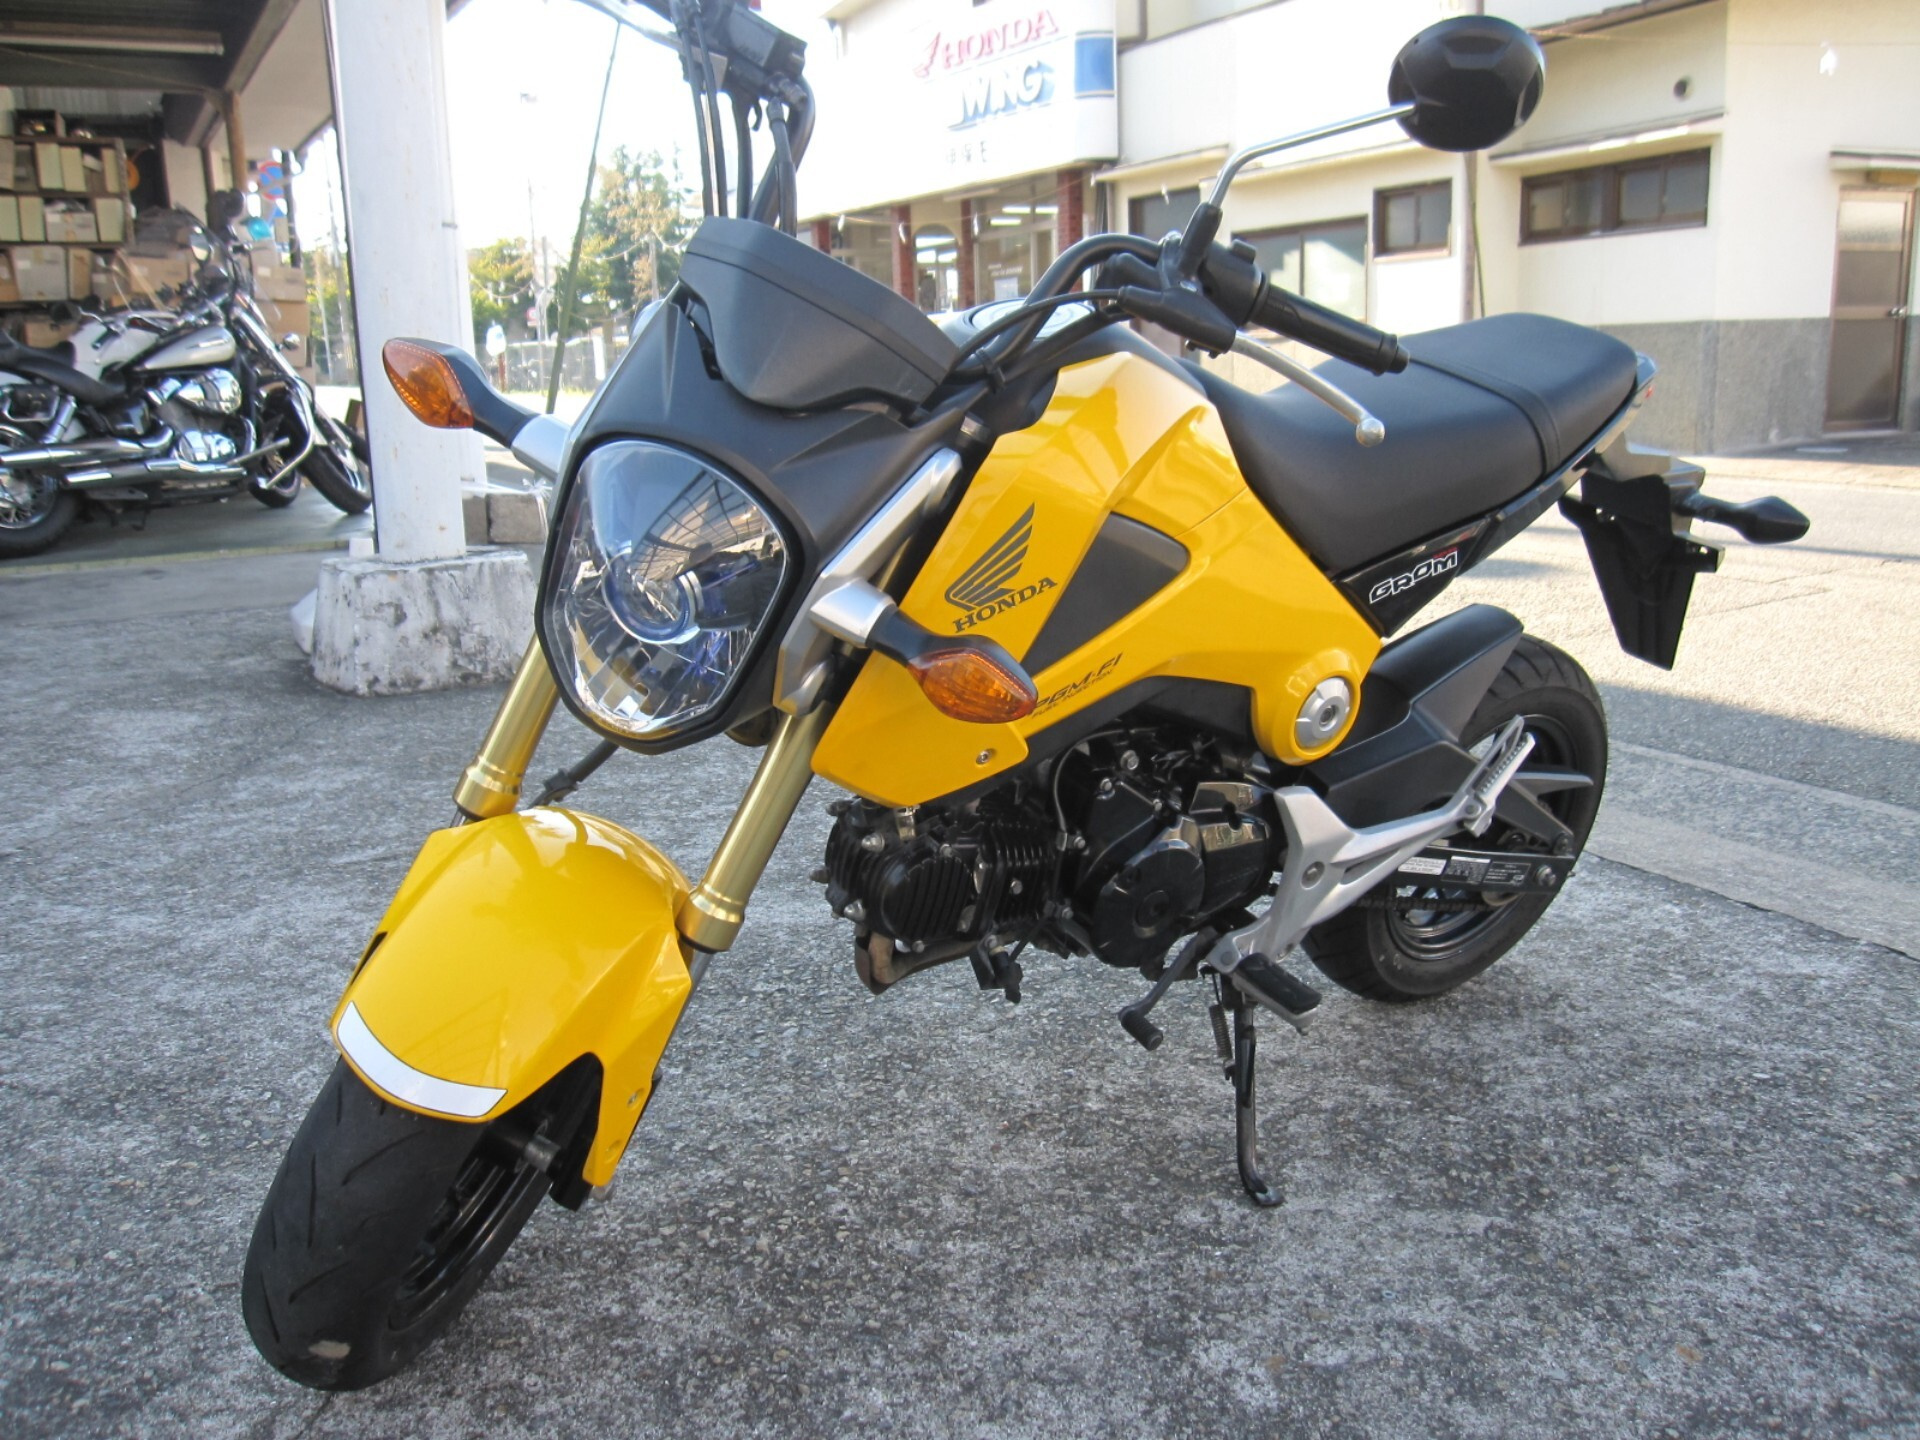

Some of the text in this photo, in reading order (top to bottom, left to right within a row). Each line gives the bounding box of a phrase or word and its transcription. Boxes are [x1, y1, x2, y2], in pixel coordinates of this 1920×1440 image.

[943, 9, 1060, 70] HONDA
[952, 577, 1058, 633] HONDA
[1368, 550, 1458, 605] GROM
